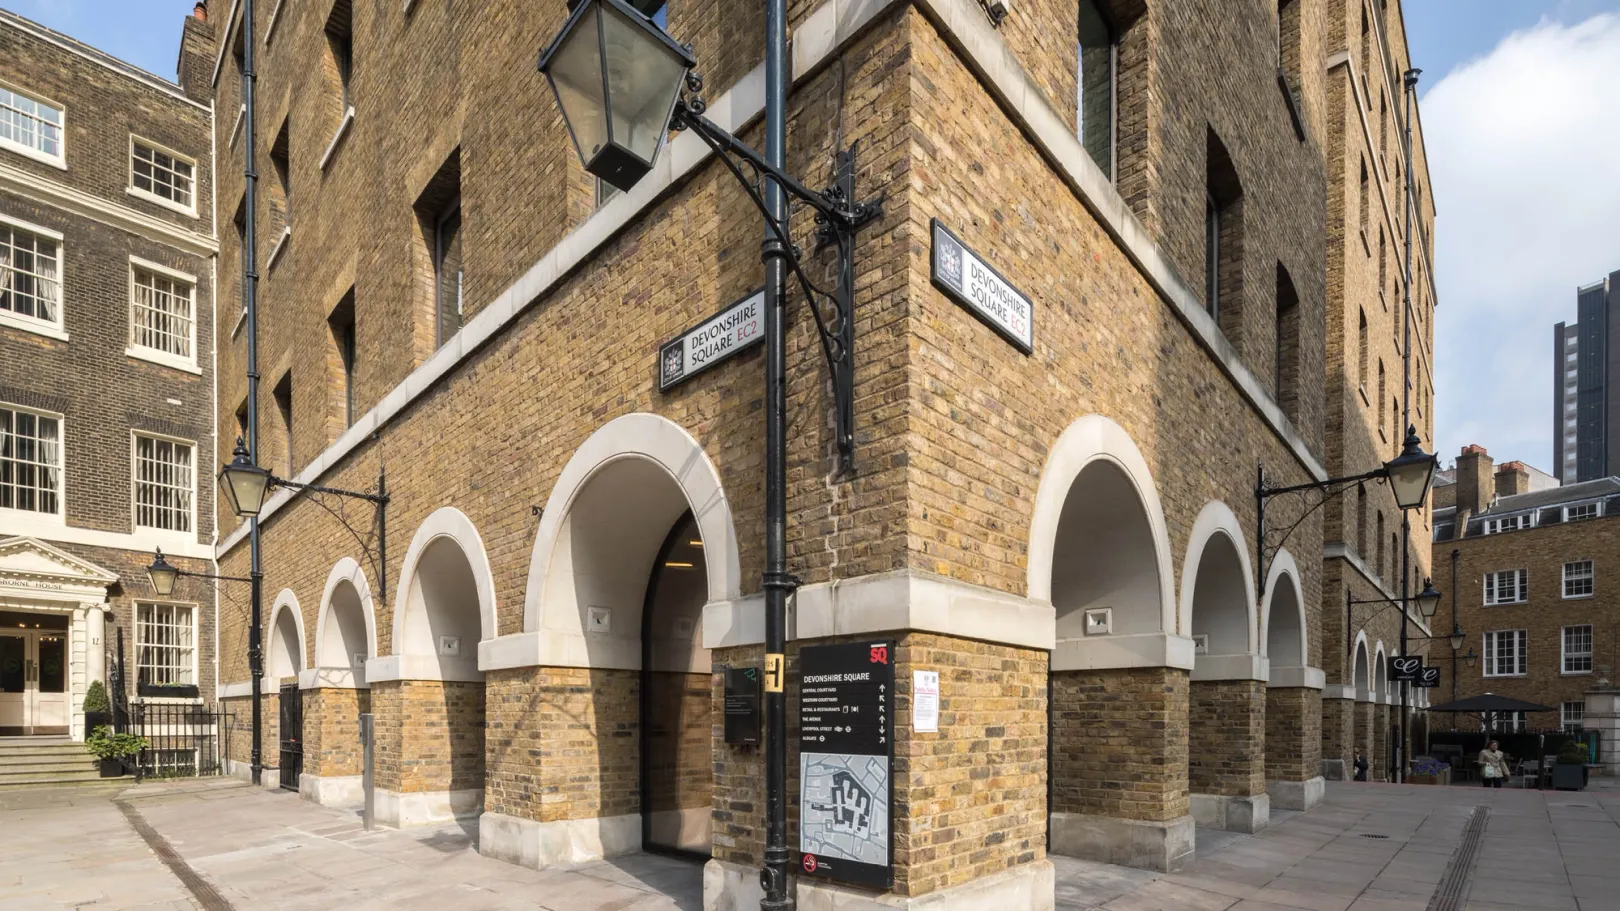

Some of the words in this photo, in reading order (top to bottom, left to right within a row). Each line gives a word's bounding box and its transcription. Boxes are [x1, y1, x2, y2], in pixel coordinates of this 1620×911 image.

[971, 263, 1026, 319] DEVONSHIRE
[691, 302, 757, 350] DEVONSHIRE
[971, 283, 1008, 323] SQUARE
[1011, 313, 1026, 337] EC2
[691, 333, 733, 366] SQUARE
[737, 320, 757, 342] EC2
[35, 582, 63, 590] HOUSE
[92, 637, 100, 646] 12
[870, 646, 888, 665] SQ
[804, 674, 842, 684] DEVONSHIRE
[844, 672, 870, 682] SQUARE
